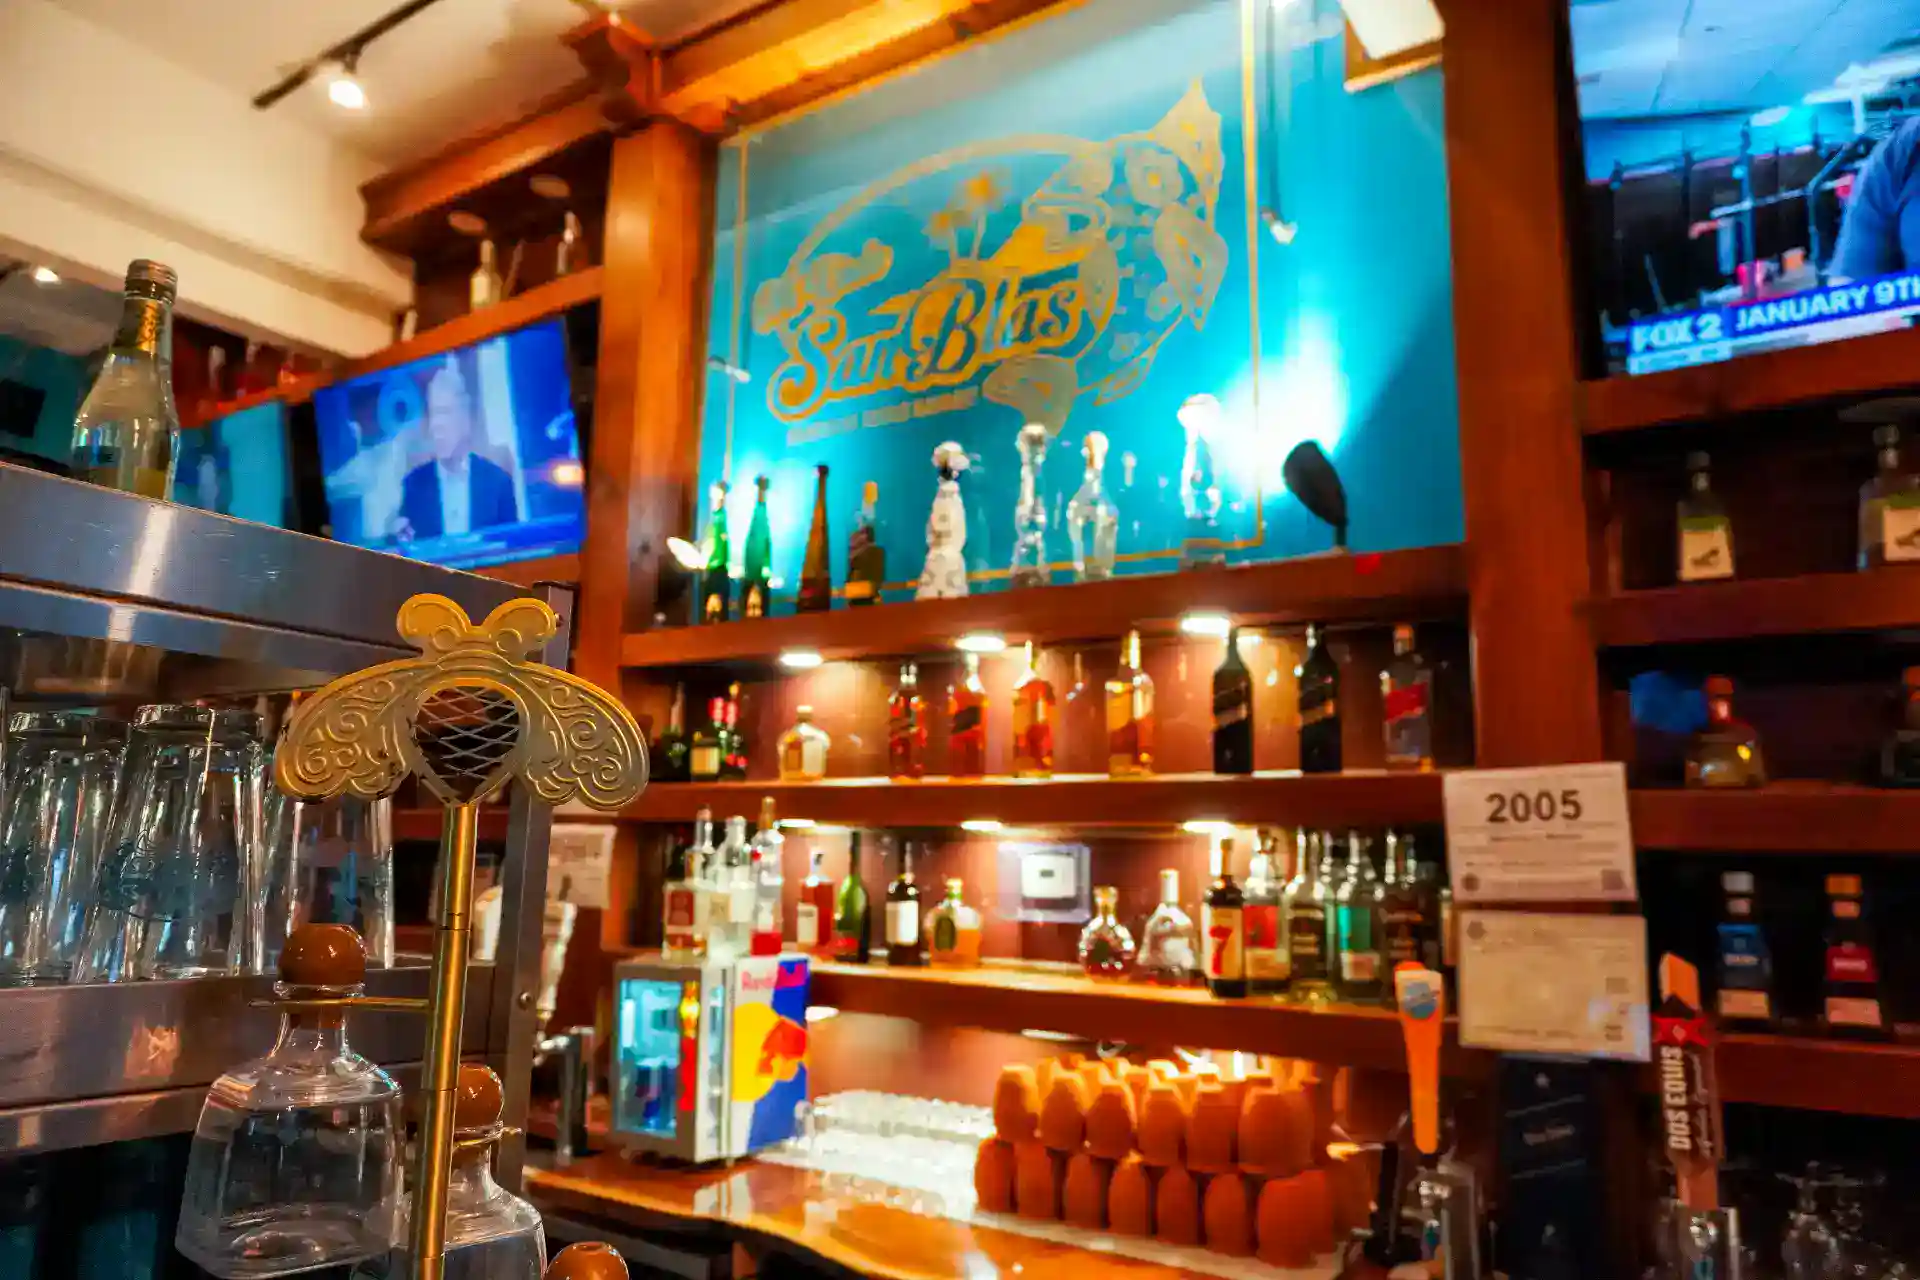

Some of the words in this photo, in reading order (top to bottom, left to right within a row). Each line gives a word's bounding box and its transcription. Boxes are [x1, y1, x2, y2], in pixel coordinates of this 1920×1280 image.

[1736, 285, 1871, 331] JANUARY
[770, 302, 898, 416] San
[901, 277, 1077, 383] Blas
[1631, 318, 1694, 353] FOX
[1696, 311, 1723, 342] 2
[1485, 788, 1583, 824] 2005
[1207, 924, 1234, 976] 7
[1660, 1045, 1688, 1107] EQUIS
[1664, 1108, 1692, 1150] DOS
